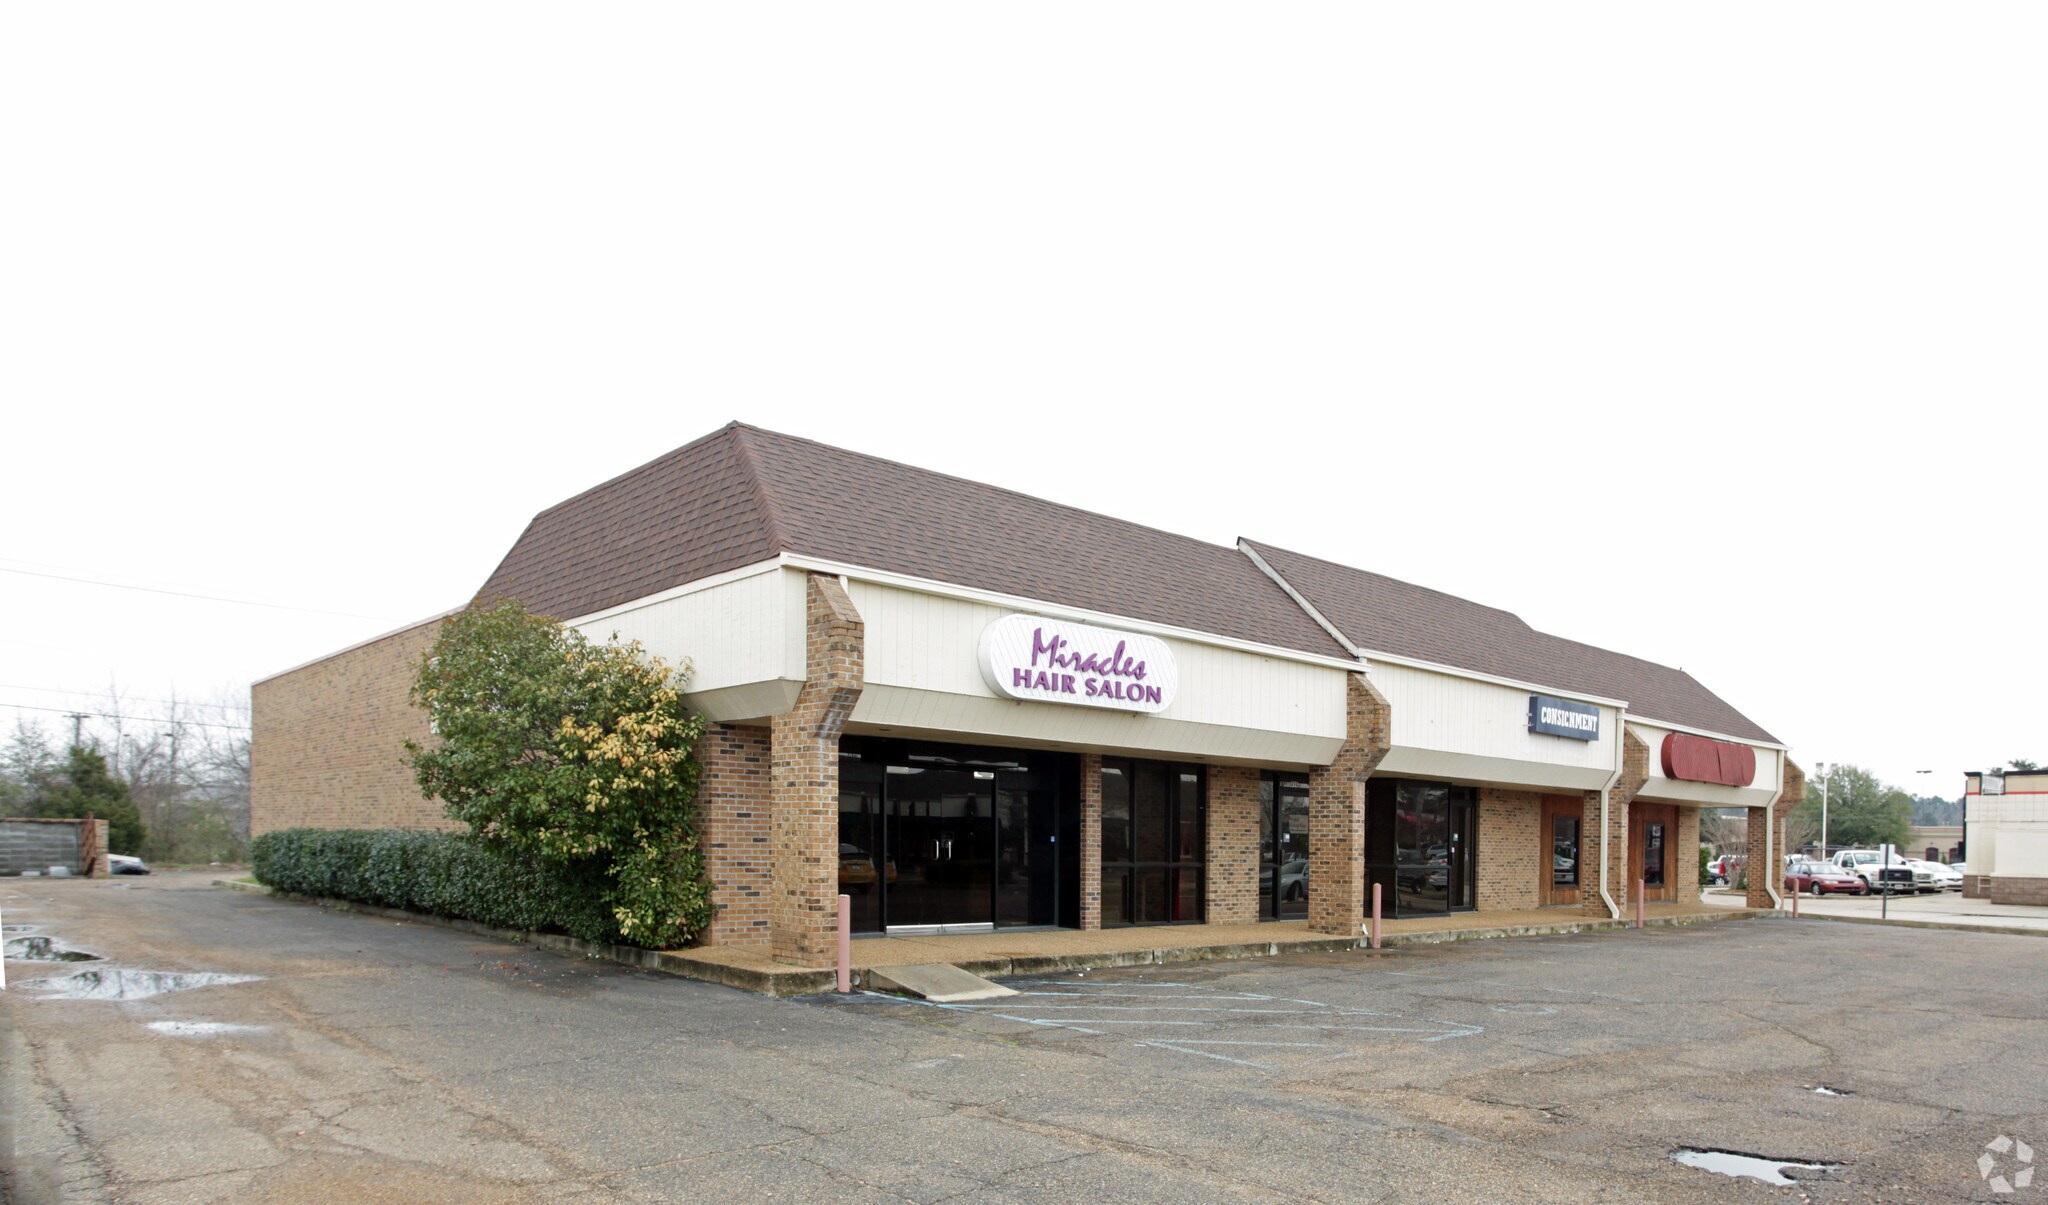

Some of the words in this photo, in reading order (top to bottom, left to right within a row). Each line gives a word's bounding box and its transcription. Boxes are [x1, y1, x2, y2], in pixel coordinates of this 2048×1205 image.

[1032, 627, 1147, 680] Miracles
[1013, 667, 1076, 694] HAIR
[1085, 677, 1162, 704] SALON
[1541, 706, 1598, 732] CONSIGNMENT
